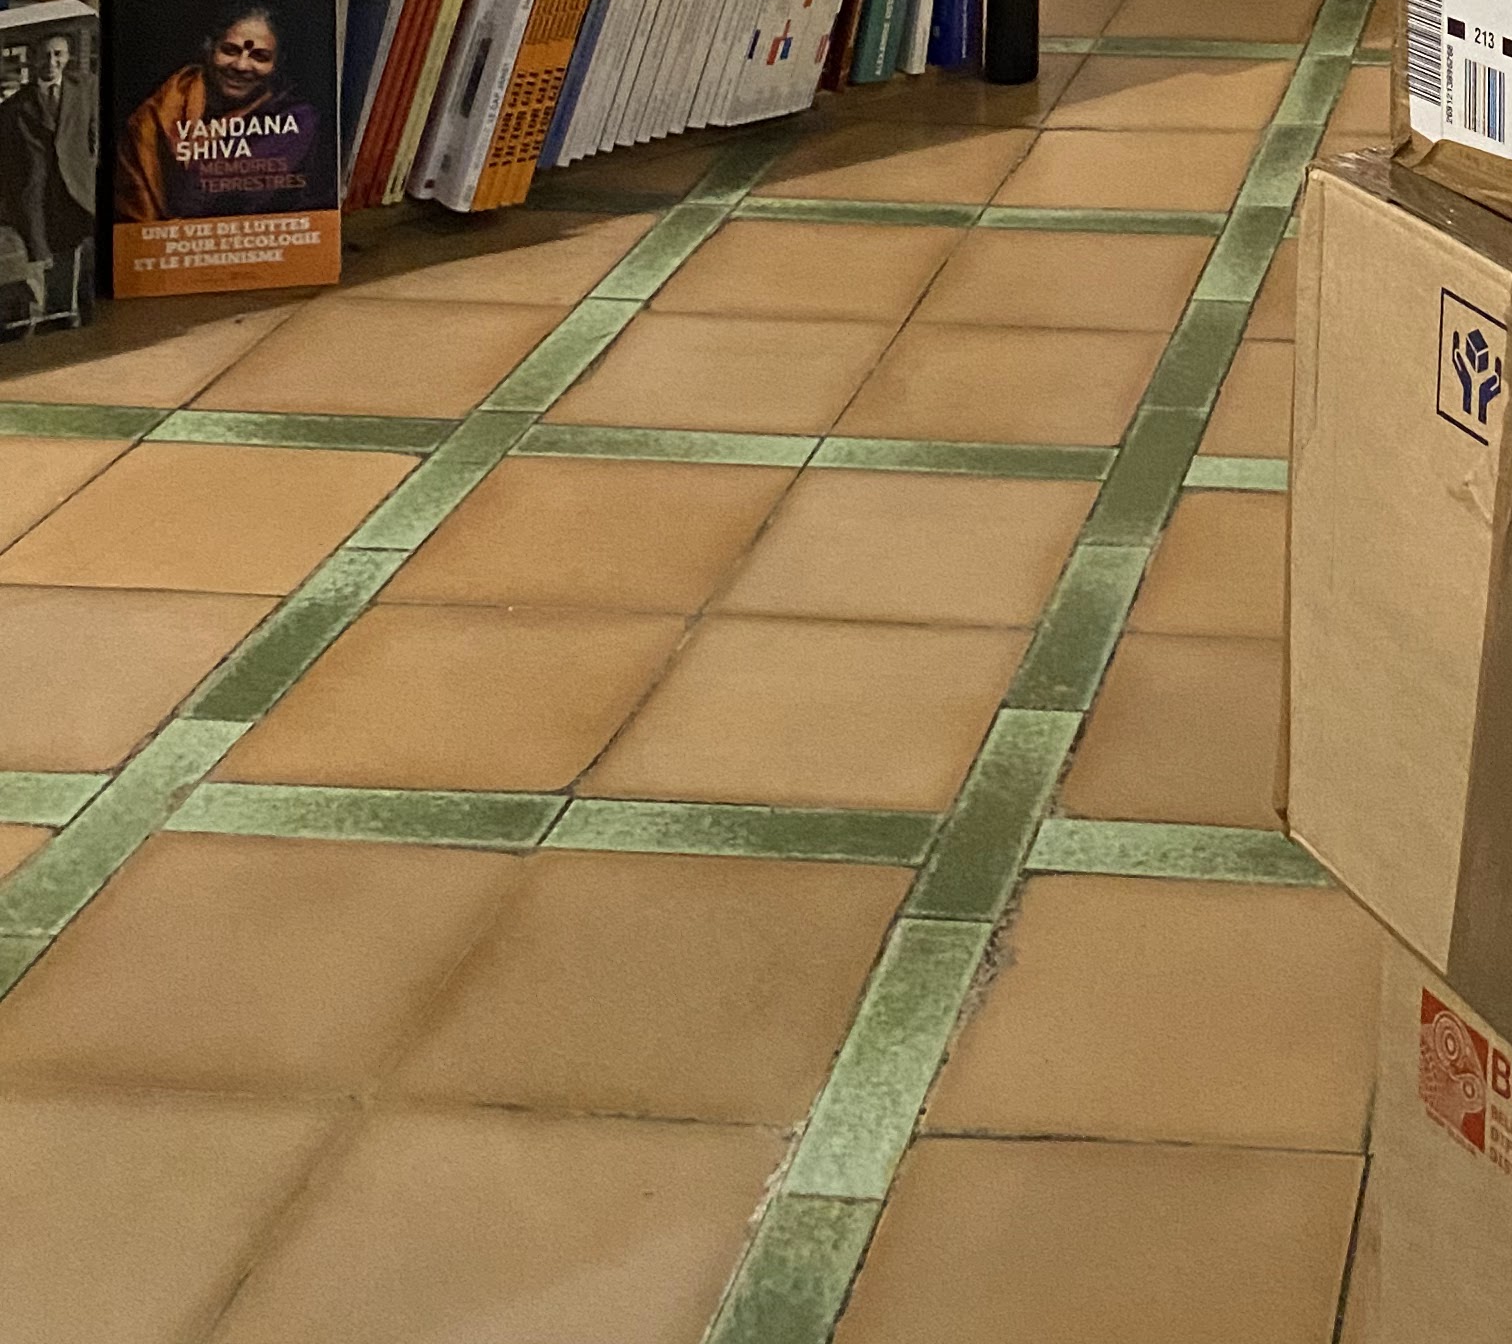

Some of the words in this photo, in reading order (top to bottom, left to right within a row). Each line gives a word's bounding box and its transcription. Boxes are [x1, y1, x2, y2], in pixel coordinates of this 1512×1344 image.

[1474, 27, 1495, 50] 213
[176, 114, 299, 140] VANDANA
[176, 137, 252, 162] SHIVA
[199, 174, 308, 193] TERRESTRES
[142, 224, 180, 241] UNE
[182, 223, 214, 239] VIE
[217, 222, 240, 236] DE
[242, 218, 310, 236] LUTTES
[166, 238, 217, 253] POUR
[221, 232, 321, 250] L'ÉCOLOGIE
[134, 256, 156, 271] ET
[159, 254, 181, 269] LE
